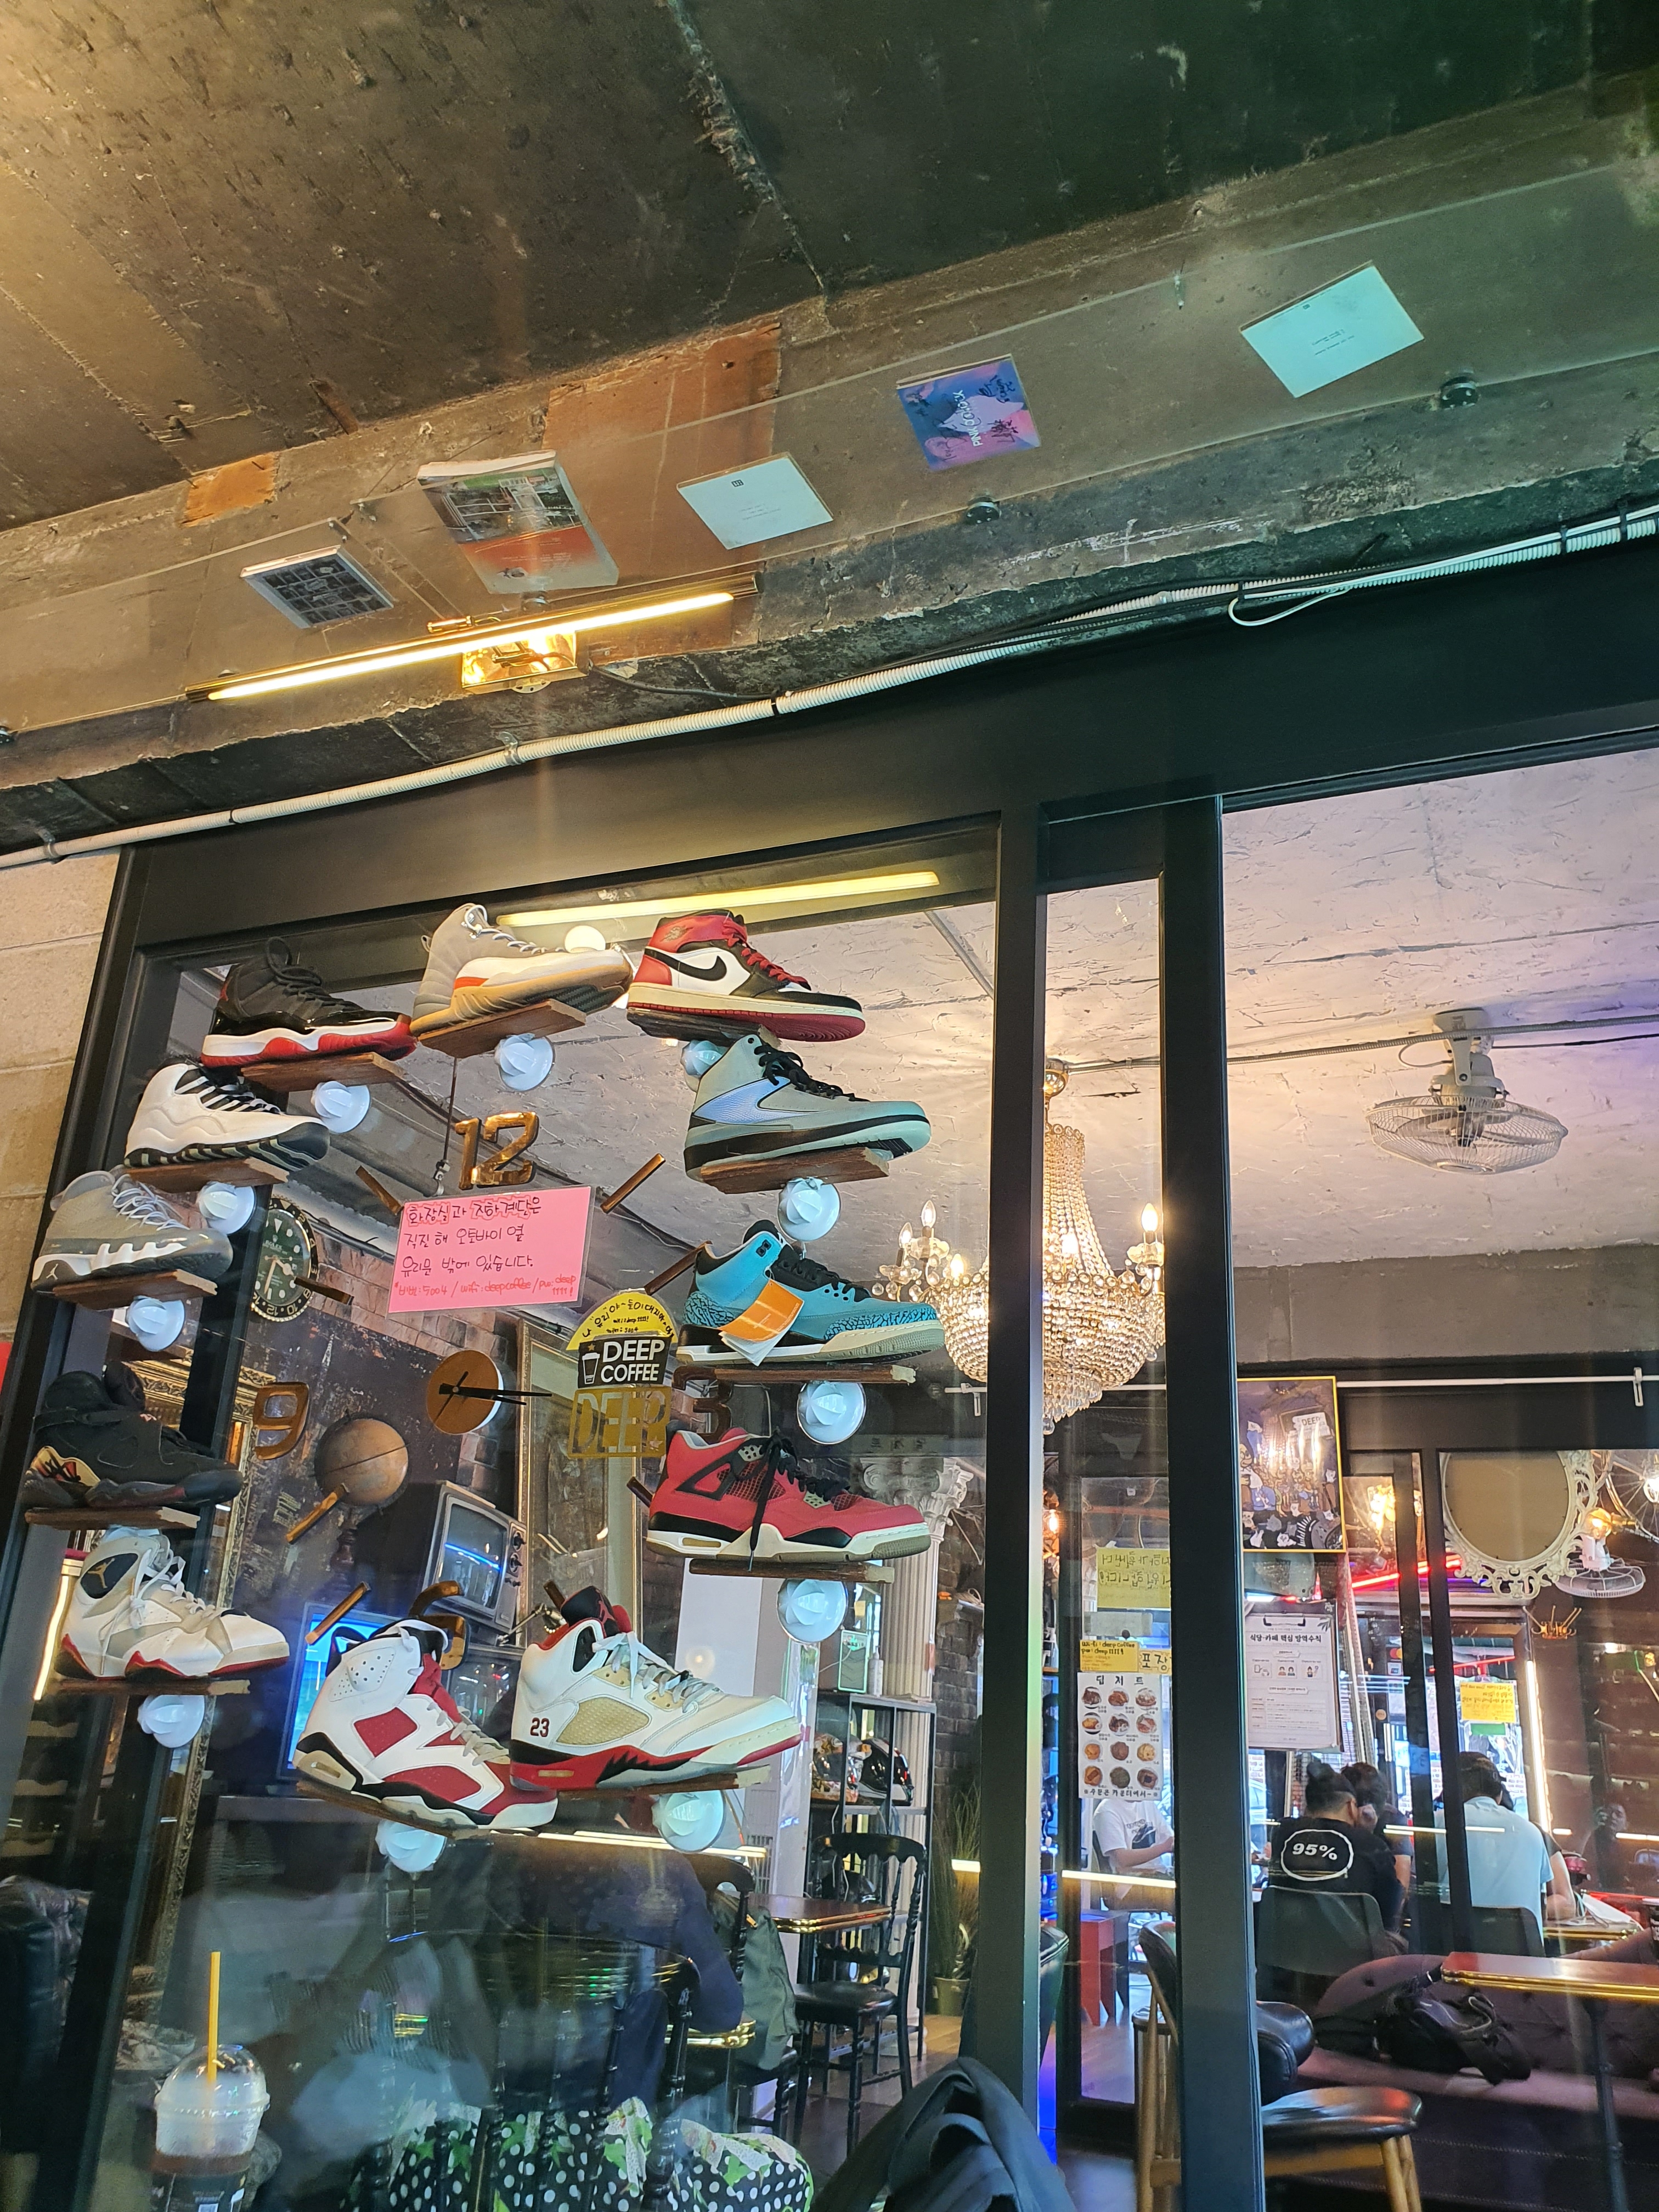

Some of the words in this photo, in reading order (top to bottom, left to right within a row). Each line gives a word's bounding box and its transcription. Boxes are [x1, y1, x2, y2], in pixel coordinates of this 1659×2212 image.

[968, 426, 984, 447] PINK
[455, 1111, 539, 1190] 12
[473, 1197, 541, 1216] 지하계단은
[456, 1228, 502, 1244] 오토바이
[507, 1224, 524, 1242] 옆
[401, 1256, 432, 1278] 유리문
[442, 1256, 470, 1273] 밖에
[476, 1254, 533, 1272] 있습니다.
[602, 1339, 665, 1363] DEEP
[601, 1363, 659, 1383] COFFEE
[572, 1390, 665, 1454] DEEP
[530, 1717, 550, 1737] 23
[1292, 1843, 1338, 1860] 95%
